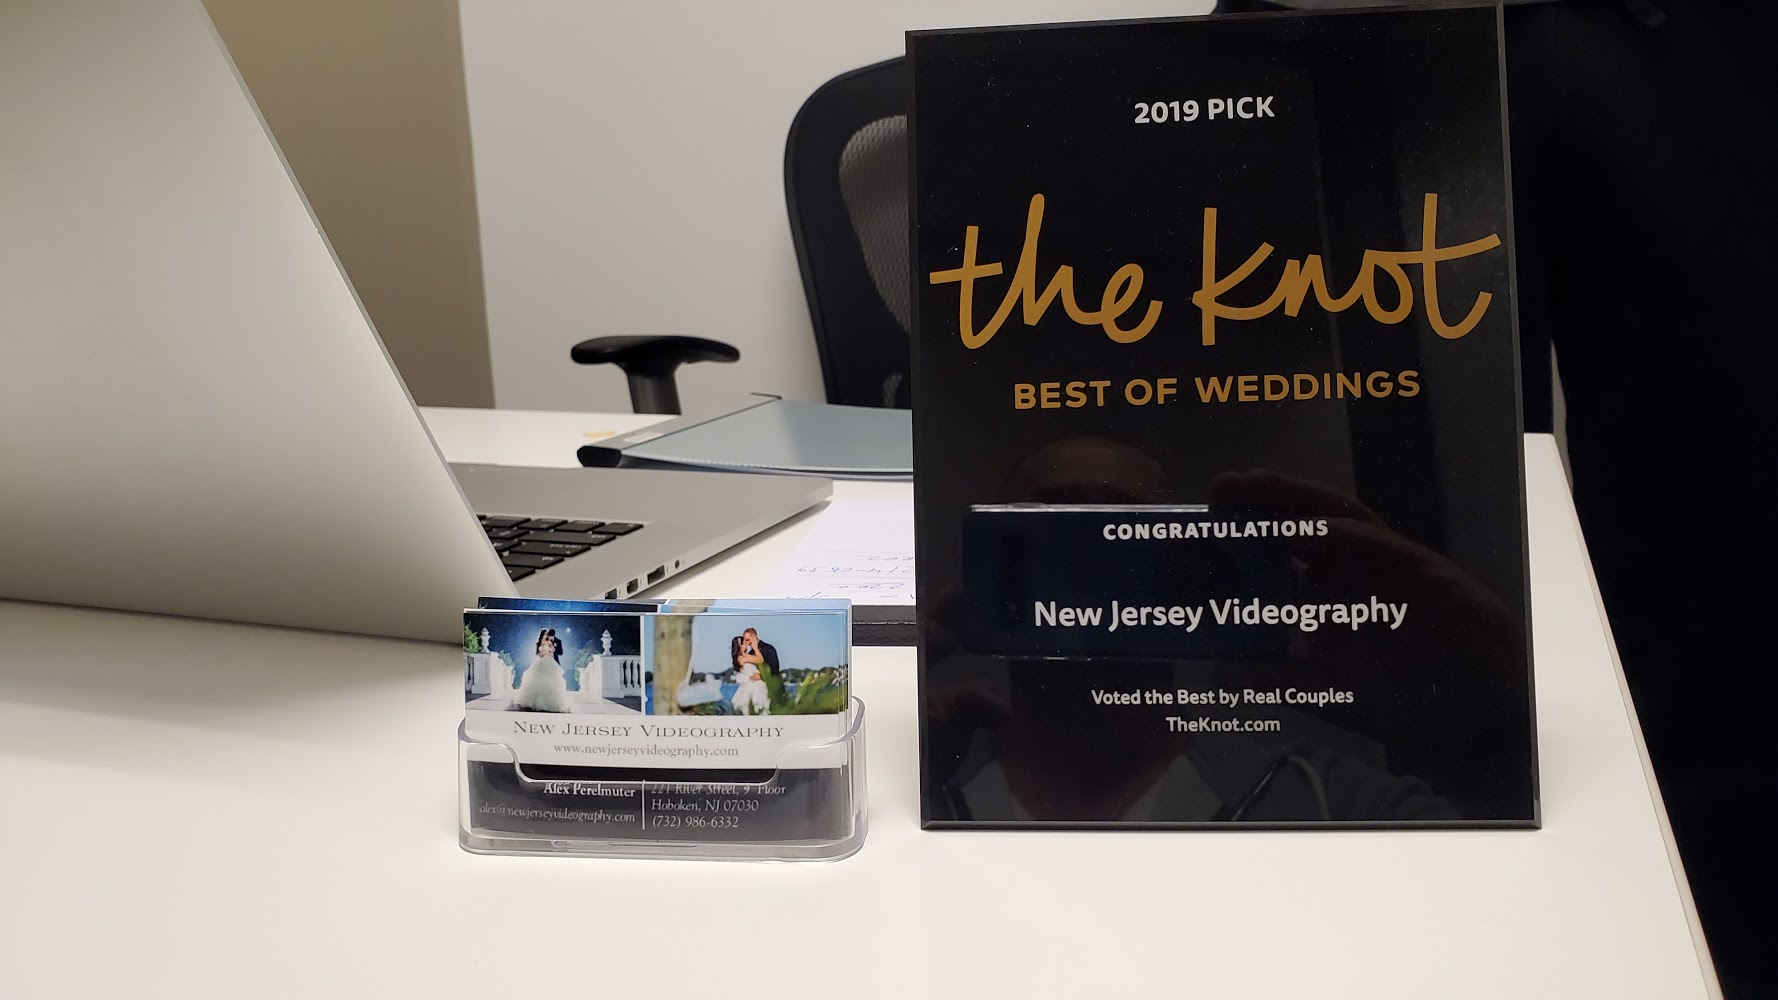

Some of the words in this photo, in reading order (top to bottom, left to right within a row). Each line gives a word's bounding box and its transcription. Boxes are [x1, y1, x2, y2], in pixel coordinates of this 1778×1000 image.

[1135, 100, 1200, 124] 2019
[1208, 96, 1275, 120] PICK
[929, 193, 1163, 349] the
[1014, 380, 1110, 410] BEST
[1124, 378, 1178, 407] OF
[1195, 370, 1421, 403] WEDDINGS
[1102, 519, 1329, 541] CONGRATULATIONS
[1034, 601, 1103, 627] New
[1108, 600, 1204, 633] Jersey
[1208, 595, 1408, 632] Videography
[1091, 689, 1142, 705] Voted
[1144, 689, 1174, 705] the
[1177, 689, 1215, 705] Best
[1218, 689, 1240, 709] by
[1243, 689, 1282, 704] Real
[1285, 687, 1355, 707] Couples
[1165, 716, 1281, 733] TheKnot.com
[553, 742, 739, 760] www.newjerseyvideography.com
[543, 782, 570, 796] Alex
[651, 799, 701, 812] Hoboken,
[705, 799, 721, 813] NJ
[723, 799, 760, 812] 07030
[652, 815, 682, 829] (732)
[685, 816, 740, 829] 986-6332
